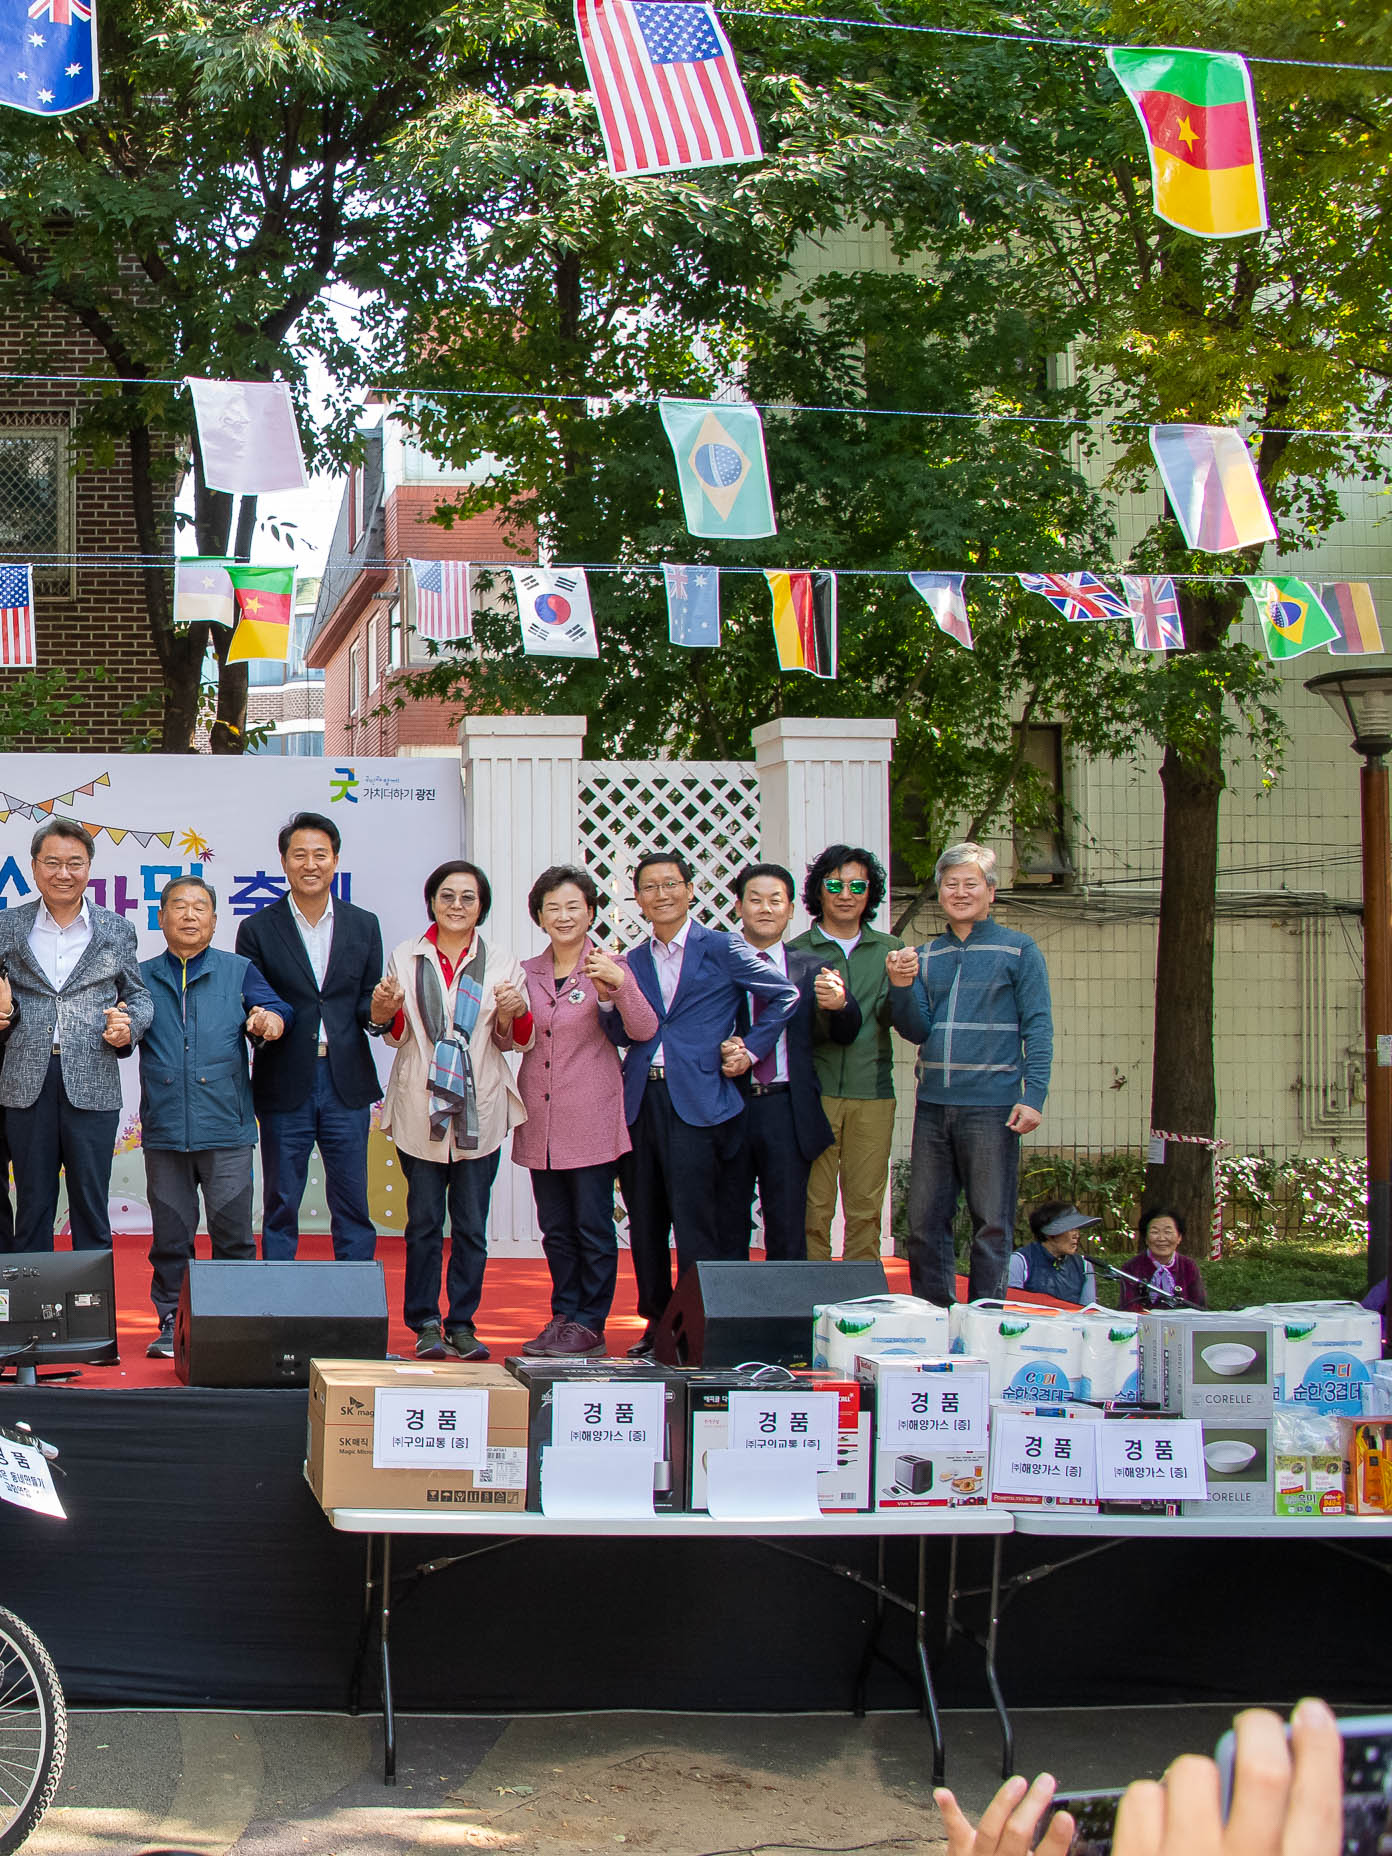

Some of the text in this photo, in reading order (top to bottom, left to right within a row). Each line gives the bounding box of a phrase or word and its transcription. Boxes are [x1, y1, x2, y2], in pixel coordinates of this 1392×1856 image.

[363, 788, 436, 801] 가치더하기 광진
[1322, 1363, 1352, 1377] 코디
[1025, 1372, 1056, 1384] CODI
[1205, 1394, 1252, 1404] CORELLE
[340, 1406, 354, 1416] SK
[1207, 1492, 1252, 1502] CORELLE
